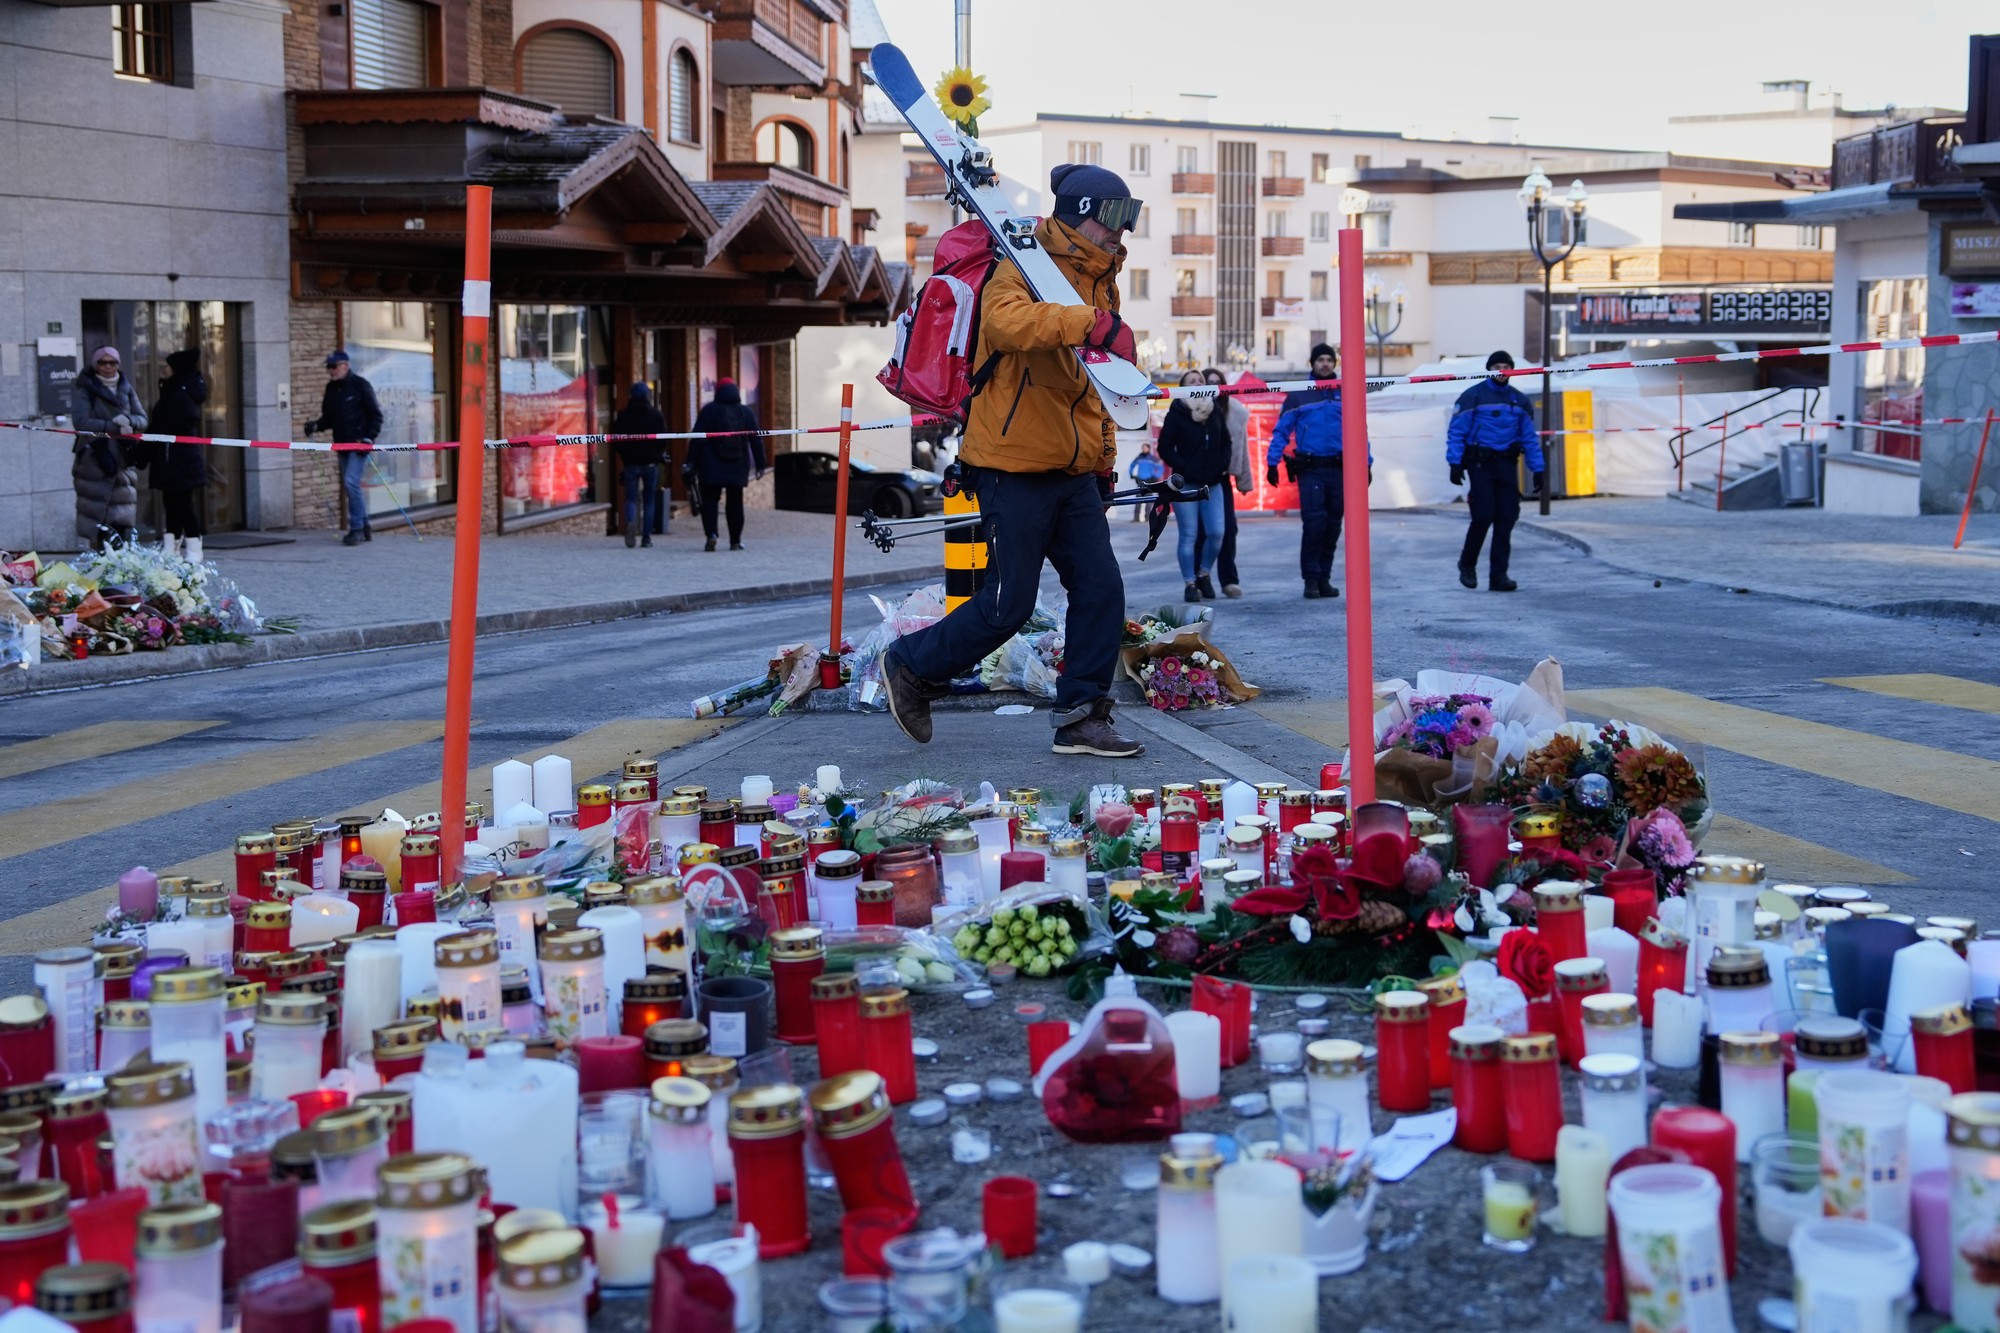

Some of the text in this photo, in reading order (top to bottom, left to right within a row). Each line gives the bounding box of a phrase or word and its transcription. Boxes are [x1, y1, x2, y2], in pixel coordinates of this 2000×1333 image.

[1631, 296, 1669, 313] rental
[1189, 389, 1216, 399] POLICE
[556, 436, 583, 446] POLICE
[585, 435, 607, 444] ZONE
